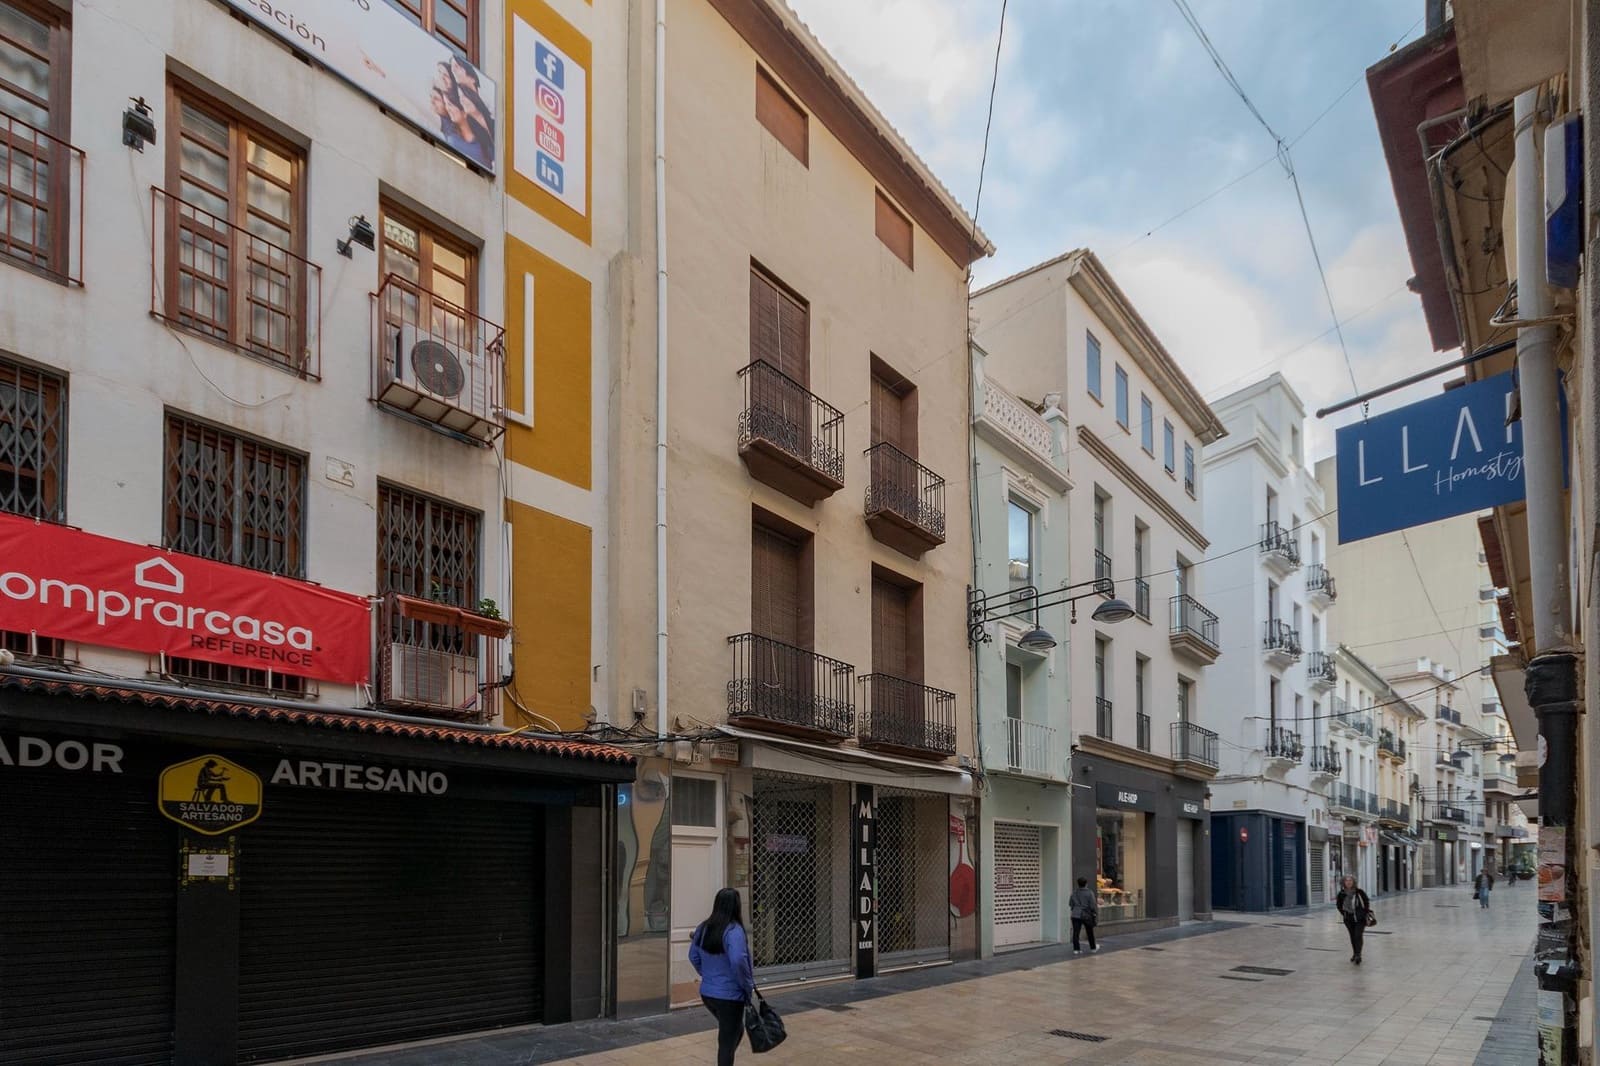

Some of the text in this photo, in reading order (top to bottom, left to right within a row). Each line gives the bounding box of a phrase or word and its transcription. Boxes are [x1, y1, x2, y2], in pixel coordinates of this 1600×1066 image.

[542, 120, 557, 138] You
[541, 158, 559, 186] in
[191, 634, 313, 667] REFERENCE
[270, 759, 448, 795] ARTESANO
[180, 802, 244, 813] SALVADOR
[181, 812, 242, 821] ARTESANO
[859, 800, 873, 938] MILADY
